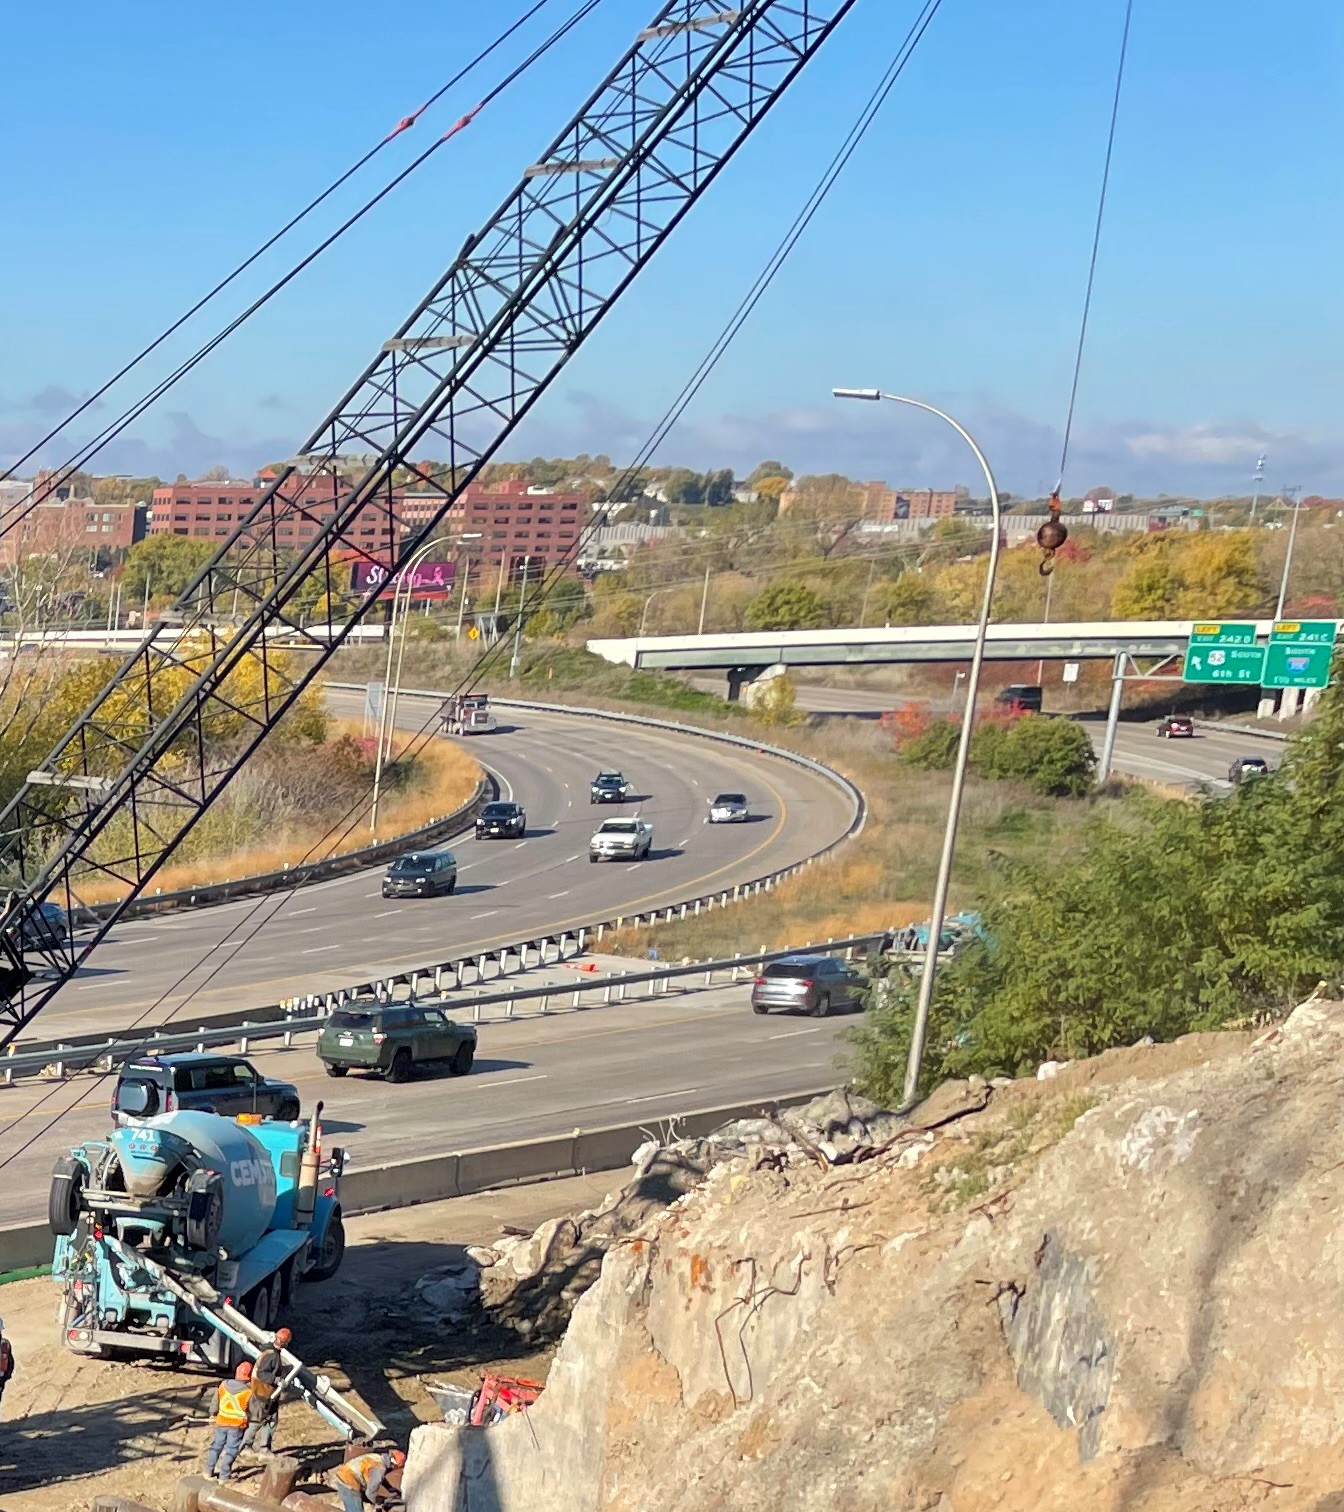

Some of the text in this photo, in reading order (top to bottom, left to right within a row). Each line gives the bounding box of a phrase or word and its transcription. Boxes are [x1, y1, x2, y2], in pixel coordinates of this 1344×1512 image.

[1209, 652, 1223, 663] 52
[1238, 669, 1251, 679] St
[131, 1128, 155, 1142] 741
